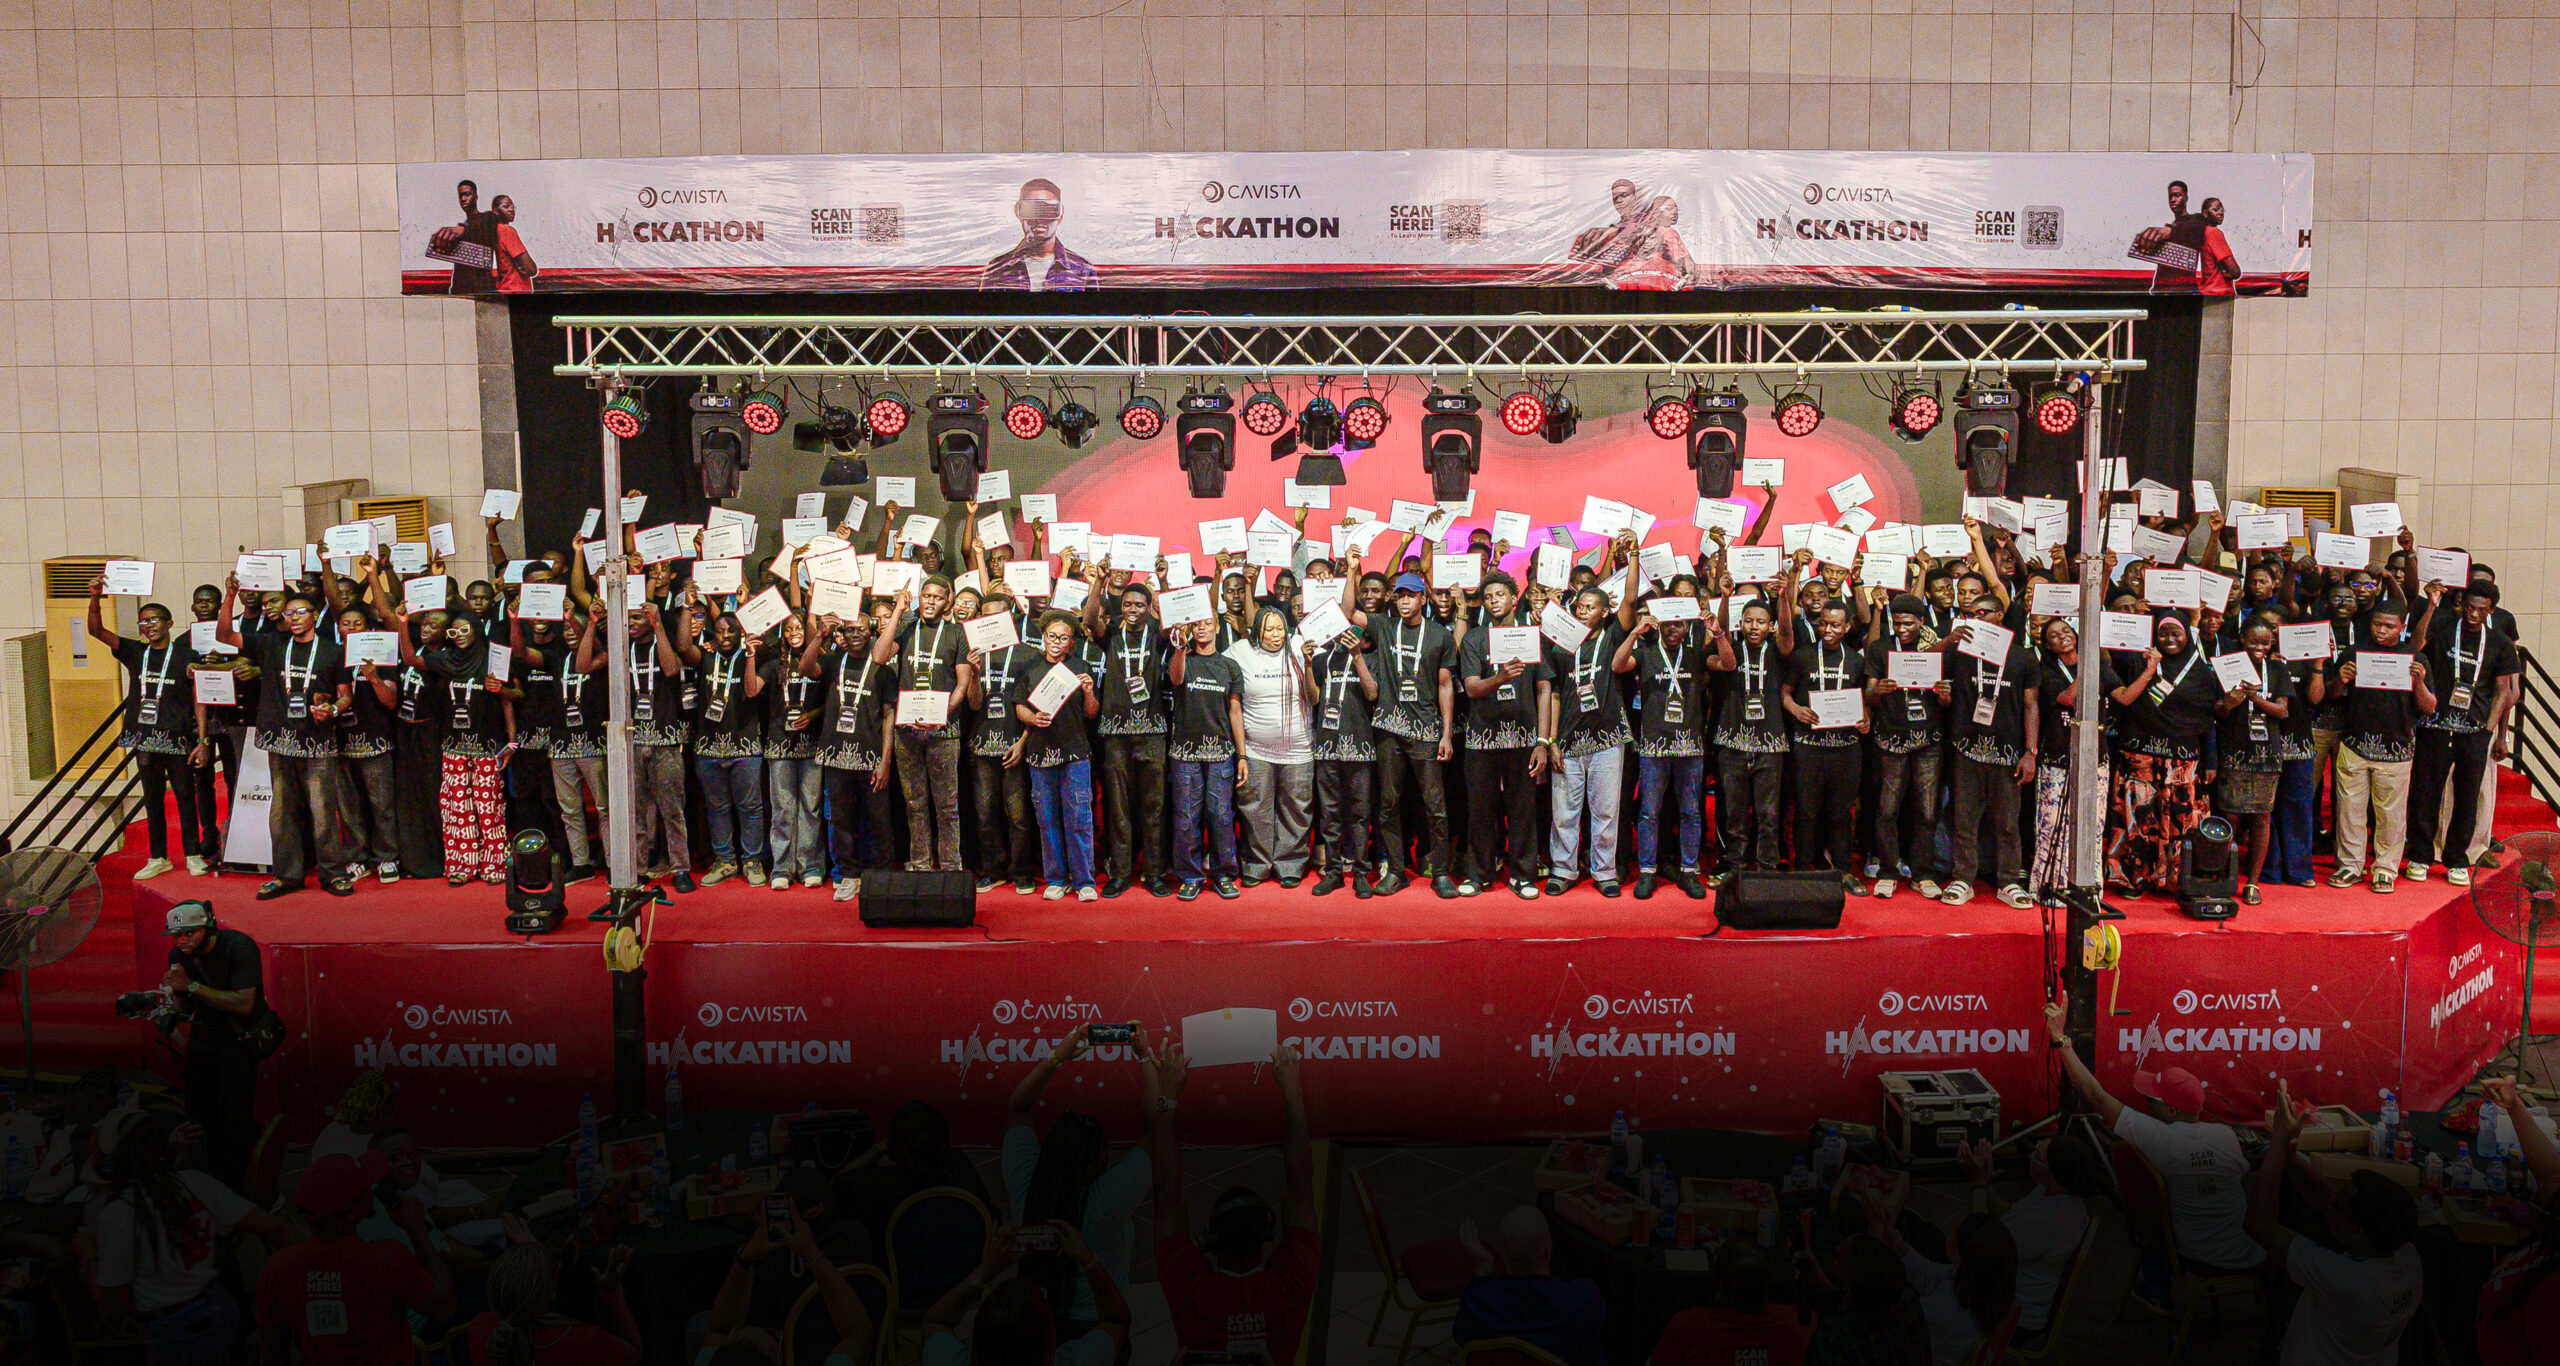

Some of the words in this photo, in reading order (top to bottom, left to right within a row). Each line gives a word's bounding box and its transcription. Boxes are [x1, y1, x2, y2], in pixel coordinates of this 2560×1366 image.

[661, 189, 728, 204] CAVISTA
[1228, 184, 1301, 199] CAVISTA
[1825, 187, 1894, 203] CAVISTA
[811, 208, 852, 221] SCAN
[1390, 205, 1433, 218] SCAN
[1975, 211, 2015, 223] SCAN
[597, 220, 764, 243] HACKATHON
[811, 222, 853, 234] HERE!
[1155, 217, 1340, 239] HACKATHON
[1390, 219, 1434, 231] HERE!
[1756, 218, 1929, 242] HACKATHON
[1975, 224, 2015, 236] HERE!
[1907, 995, 1988, 1011] CAVISTA
[2201, 993, 2281, 1010] CAVISTA
[2430, 964, 2494, 1029] HACKATHON
[726, 1006, 808, 1022] CAVISTA
[1021, 1003, 1102, 1020] CAVISTA
[1317, 1001, 1398, 1017] CAVISTA
[1612, 998, 1694, 1014] CAVISTA
[432, 1008, 512, 1025] CAVISTA
[1531, 1032, 1735, 1057] HACKATHON
[1825, 1028, 2030, 1054] HACKATHON
[2119, 1027, 2321, 1052] HACKATHON
[354, 1042, 557, 1067] HACKATHON
[647, 1040, 851, 1065] HACKATHON
[306, 1270, 341, 1281] SCAN
